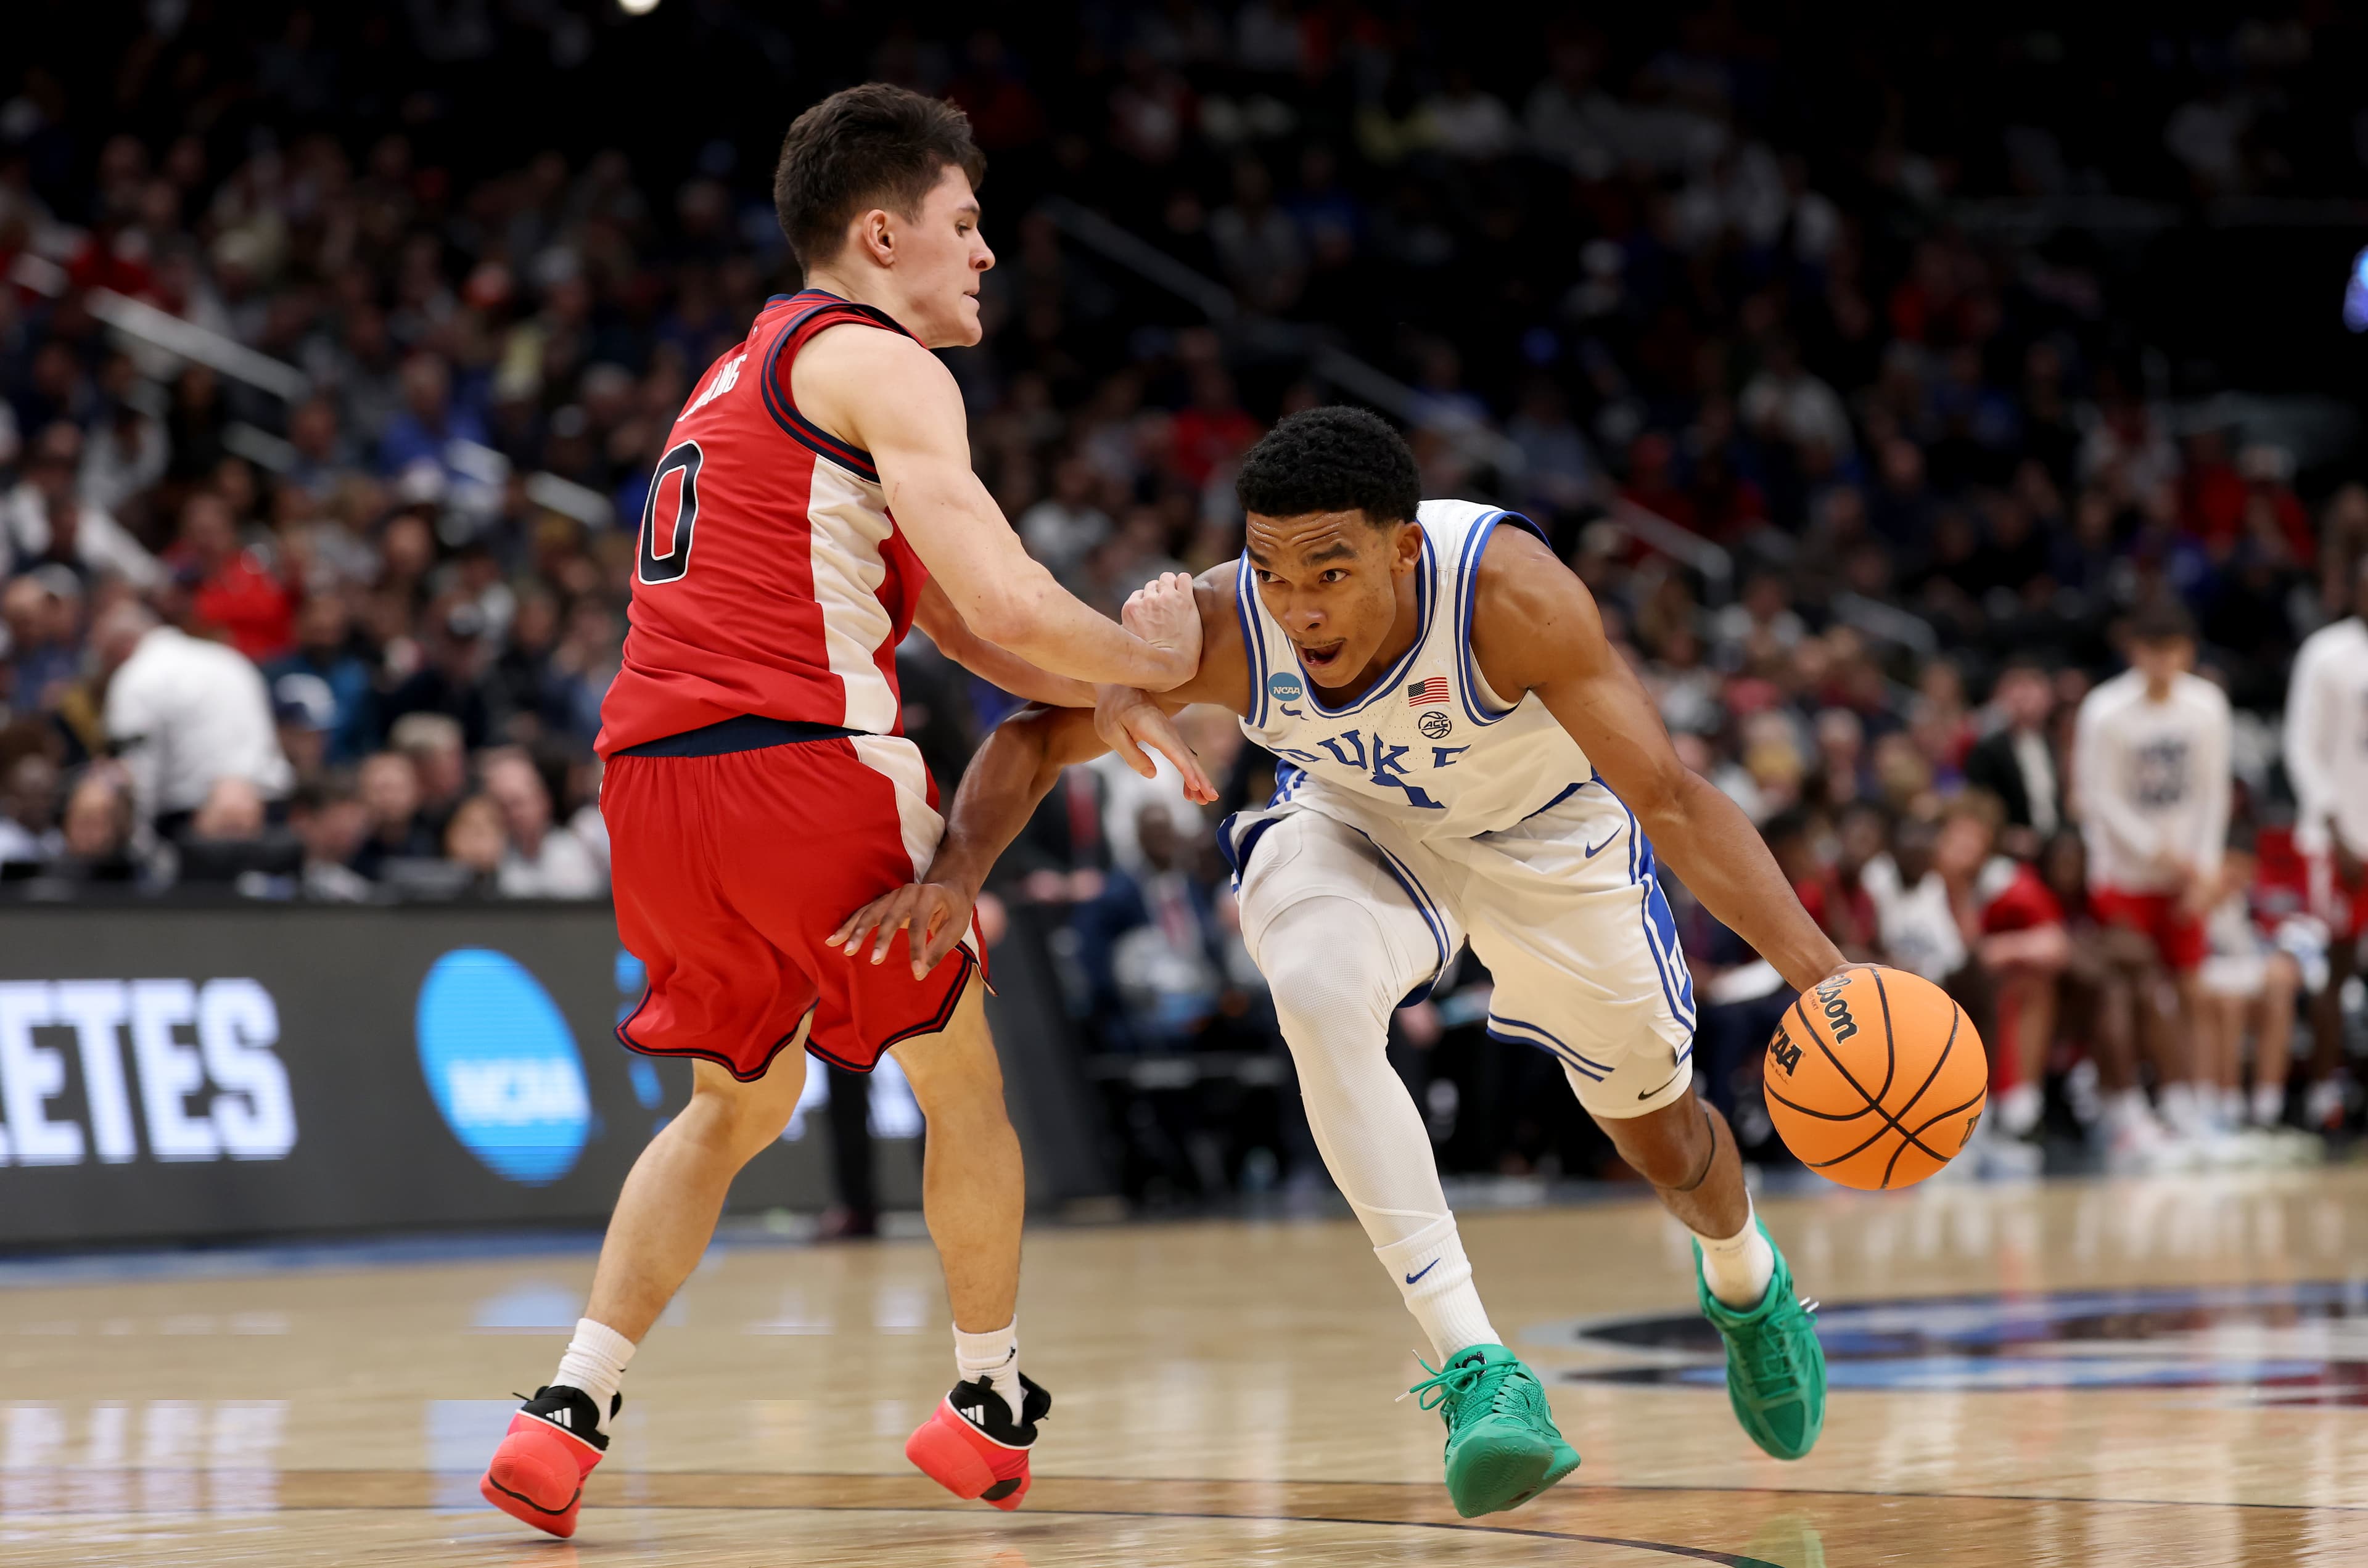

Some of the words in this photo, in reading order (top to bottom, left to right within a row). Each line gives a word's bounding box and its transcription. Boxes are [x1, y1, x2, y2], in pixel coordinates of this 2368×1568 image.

[638, 439, 704, 586] 0
[1273, 686, 1301, 695] NCAA
[1421, 719, 1449, 729] ACC
[1815, 974, 1859, 1045] ilson
[0, 977, 298, 1167] ETES
[1770, 1020, 1803, 1077] CAA
